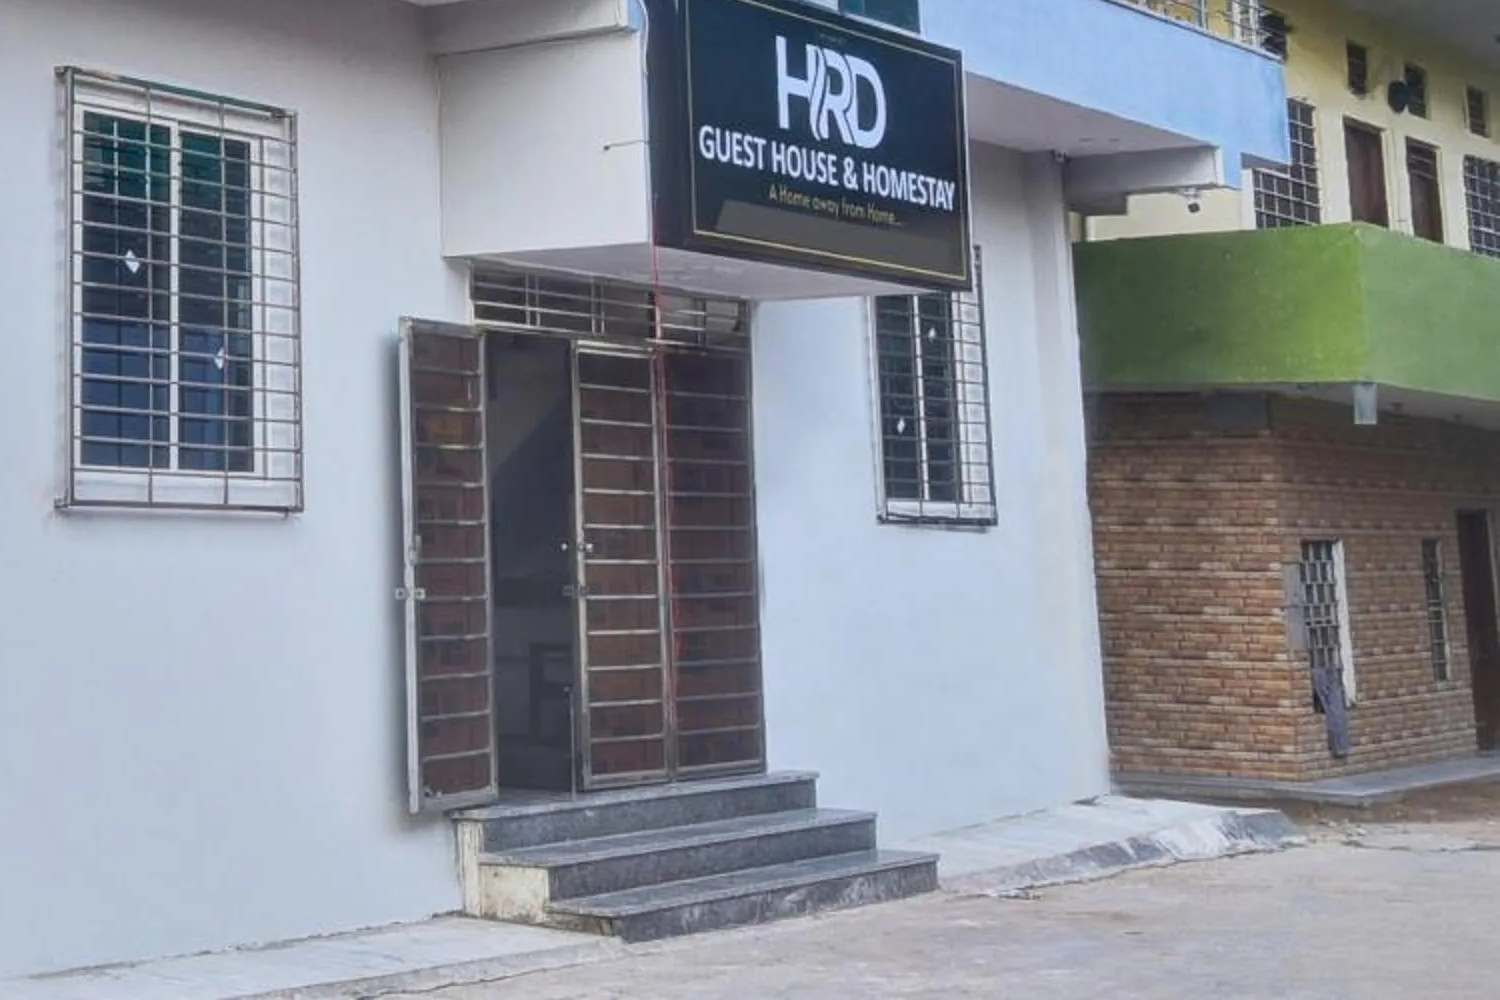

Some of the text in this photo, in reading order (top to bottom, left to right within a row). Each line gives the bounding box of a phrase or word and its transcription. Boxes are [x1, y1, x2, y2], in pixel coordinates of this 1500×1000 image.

[775, 35, 887, 149] HRD
[699, 124, 956, 211] GUEST HOUSE & HOMESTAY
[769, 184, 777, 200] A
[779, 185, 810, 209] Home
[812, 197, 839, 220] away
[841, 197, 866, 219] from
